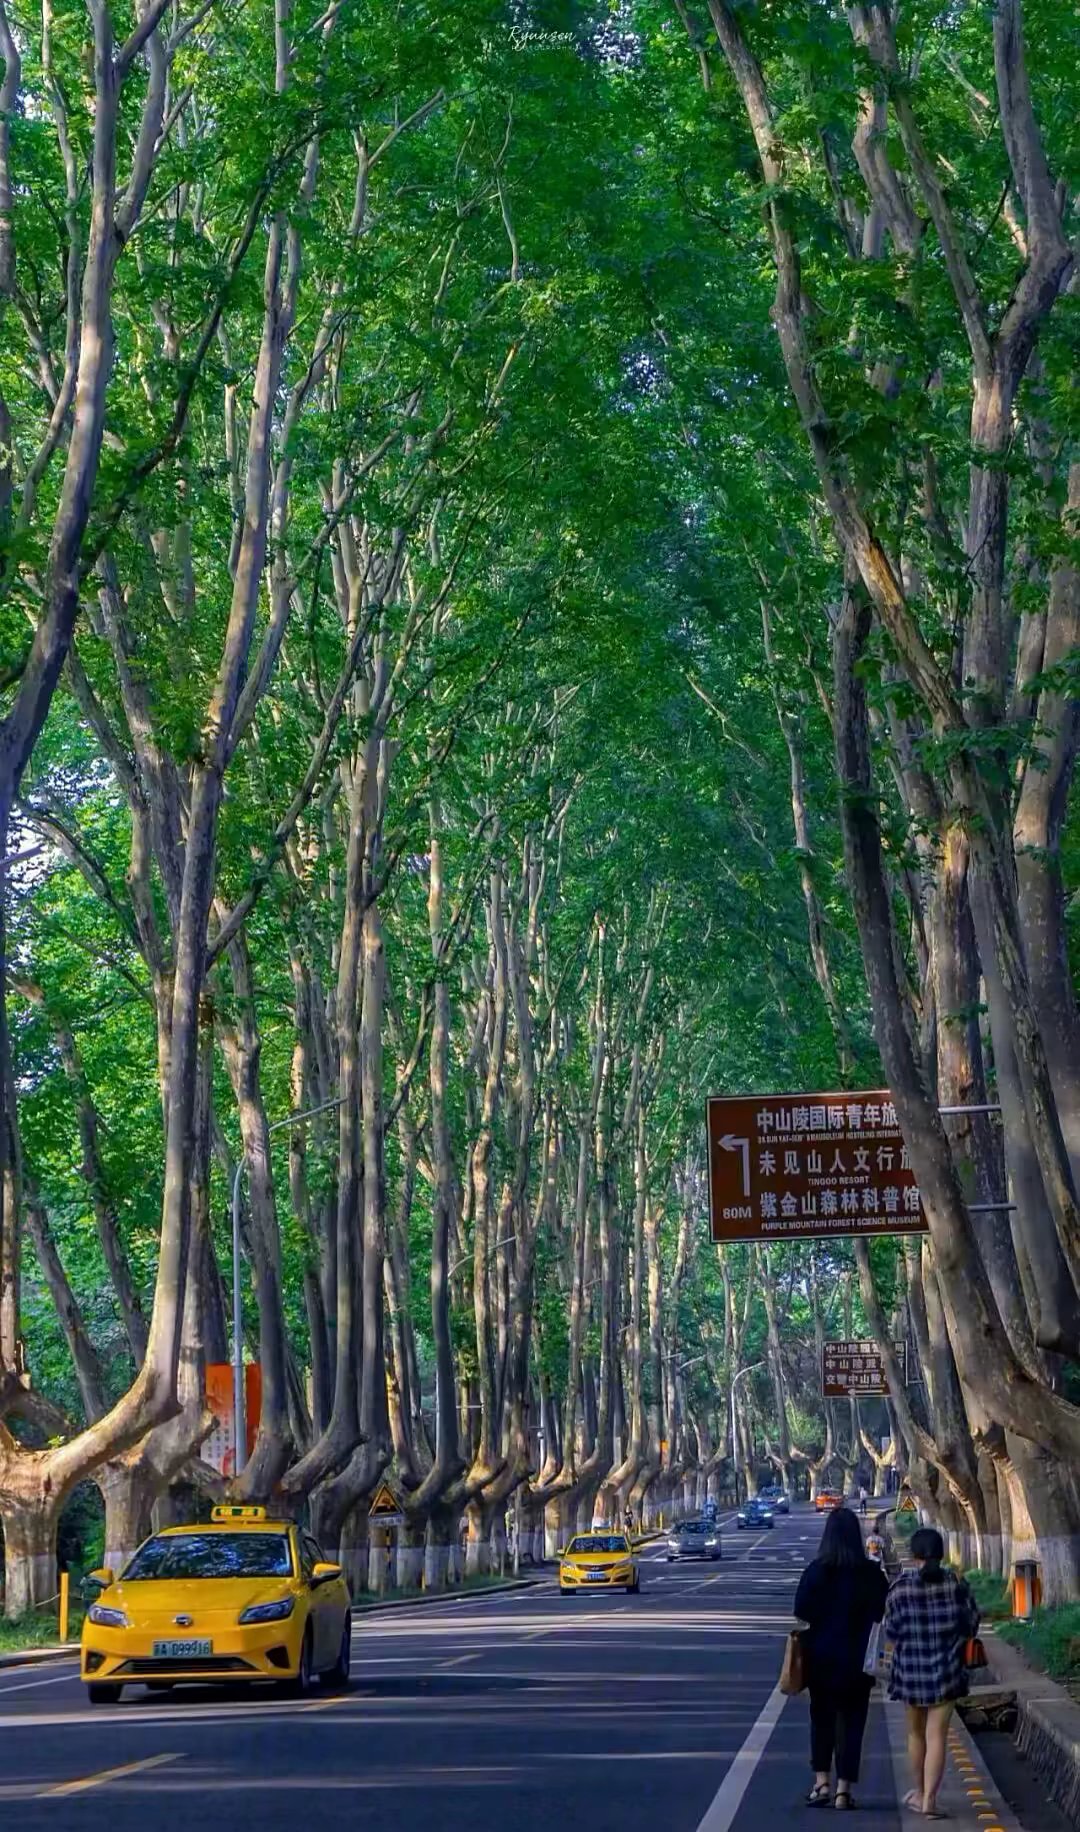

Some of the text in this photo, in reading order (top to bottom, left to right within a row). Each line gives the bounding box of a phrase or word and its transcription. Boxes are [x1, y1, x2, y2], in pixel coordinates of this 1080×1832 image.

[757, 1101, 899, 1133] 中山陵国际青年旅
[840, 1175, 869, 1185] RESORT
[760, 1185, 920, 1218] 紫金山森林科普馆
[723, 1206, 752, 1219] 80M
[761, 1215, 920, 1231] PURPLE MOUNTAIN FOREST SCIENCE MUSEUM
